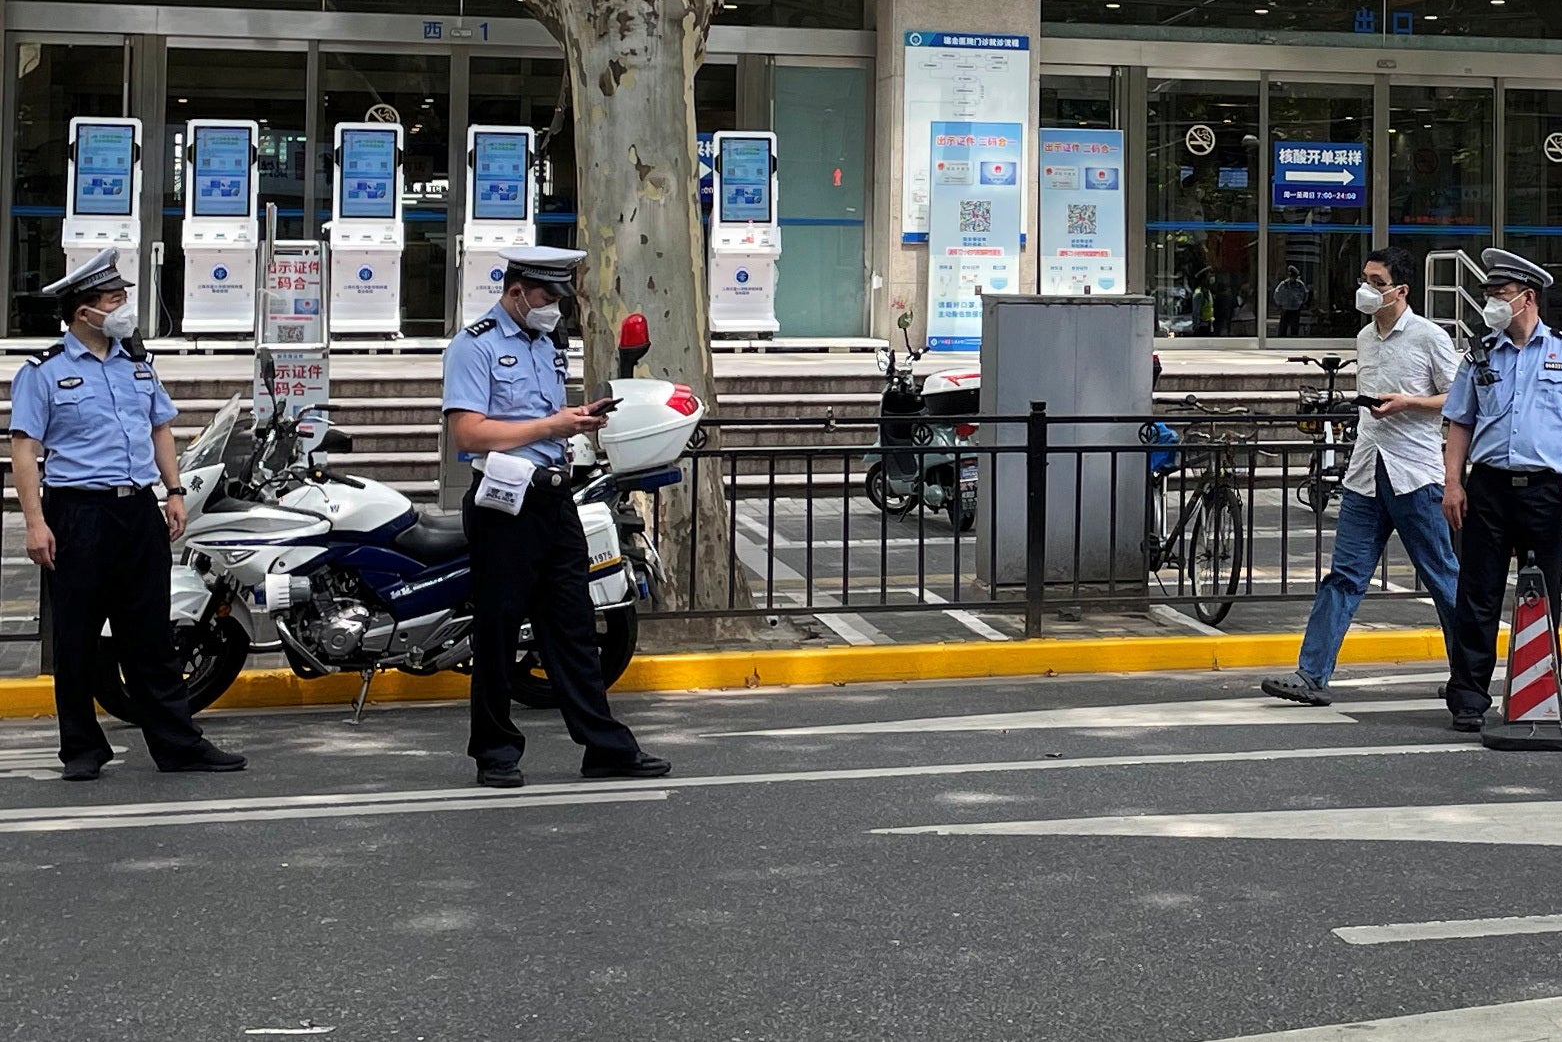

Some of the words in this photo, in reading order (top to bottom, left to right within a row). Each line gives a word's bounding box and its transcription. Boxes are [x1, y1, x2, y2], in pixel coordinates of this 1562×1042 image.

[423, 21, 443, 39] 西
[479, 22, 488, 41] 1
[1355, 8, 1414, 35] 出口
[1279, 148, 1362, 166] 核酸开单采样
[260, 365, 323, 380] 示证件
